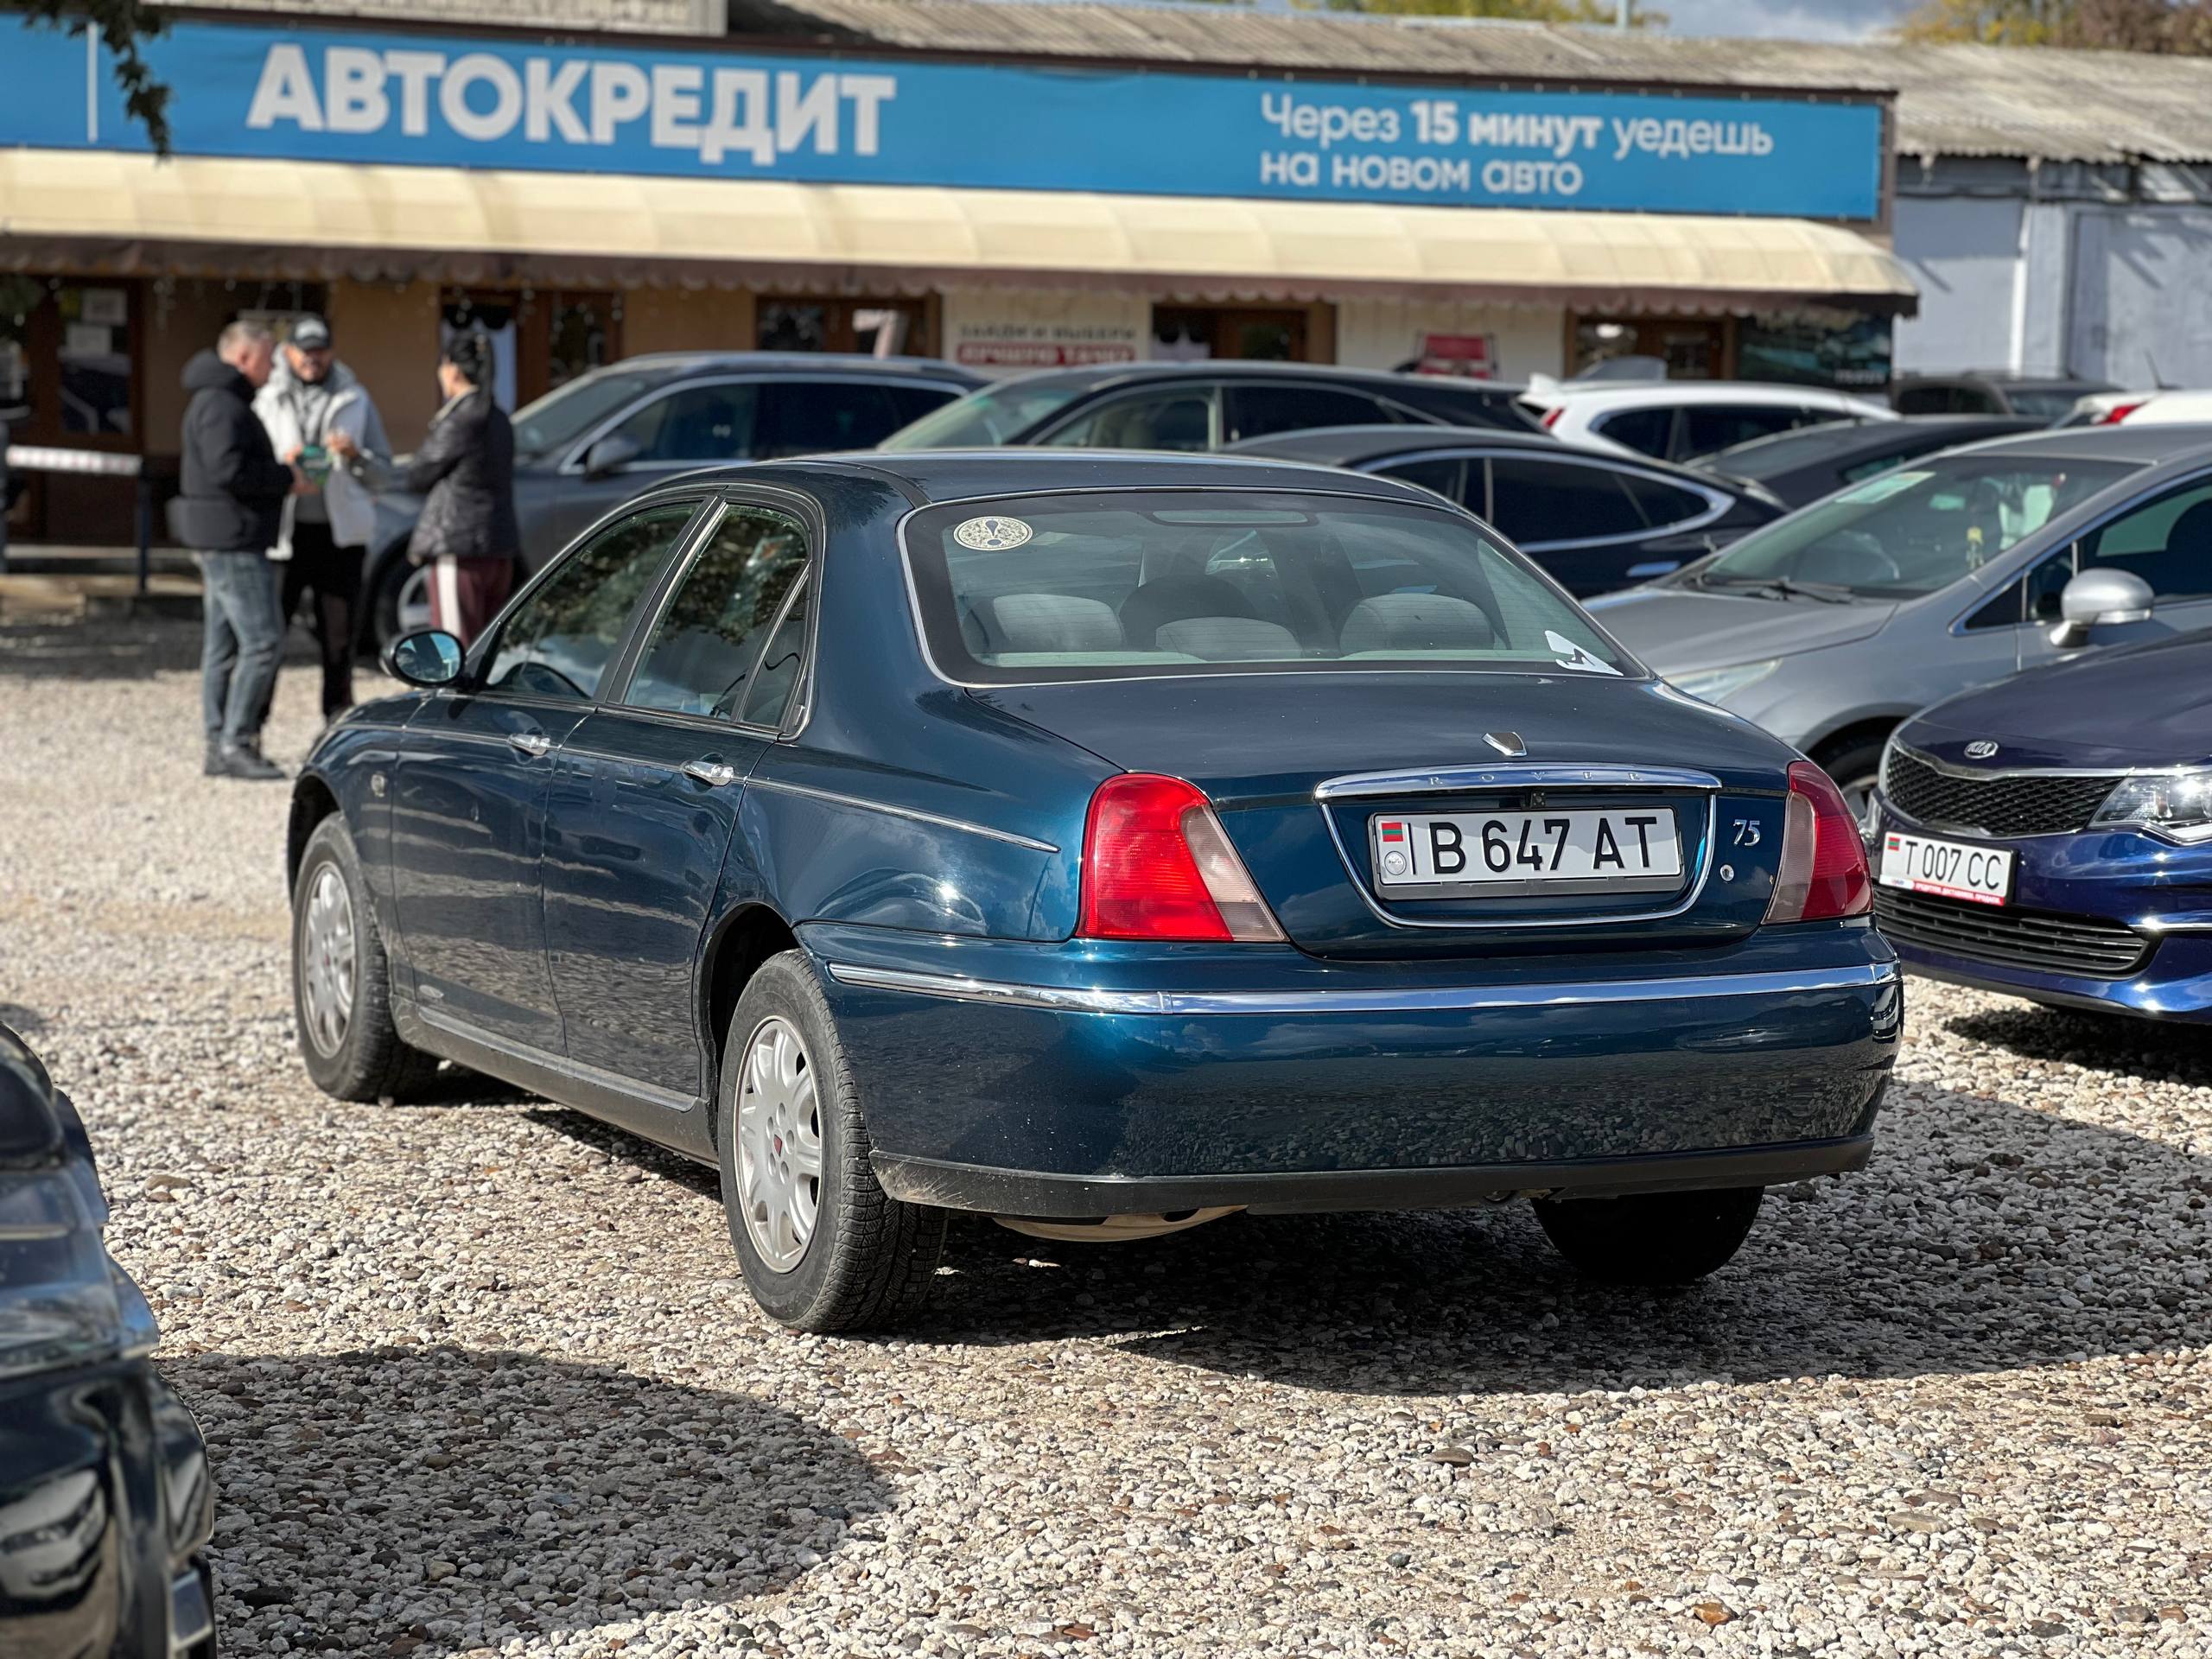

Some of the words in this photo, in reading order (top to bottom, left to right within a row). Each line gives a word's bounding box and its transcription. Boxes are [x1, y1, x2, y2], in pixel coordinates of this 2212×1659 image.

[245, 43, 898, 166] АВТОКРЕДИТ
[1261, 92, 1401, 150] Через
[1409, 99, 1459, 145] 15
[1469, 112, 1604, 158] минут
[1612, 117, 1774, 161] уедешь
[1260, 150, 1319, 187] на
[1332, 154, 1469, 192] новом
[1481, 159, 1584, 195] авто
[1428, 771, 1643, 786] ROVER
[1428, 822, 1466, 874] B
[1481, 819, 1571, 873] 647
[1592, 817, 1657, 870] AT
[1732, 819, 1761, 847] 75
[1905, 840, 1919, 875] T
[1922, 843, 1962, 883] 007
[1967, 852, 2002, 890] CC
